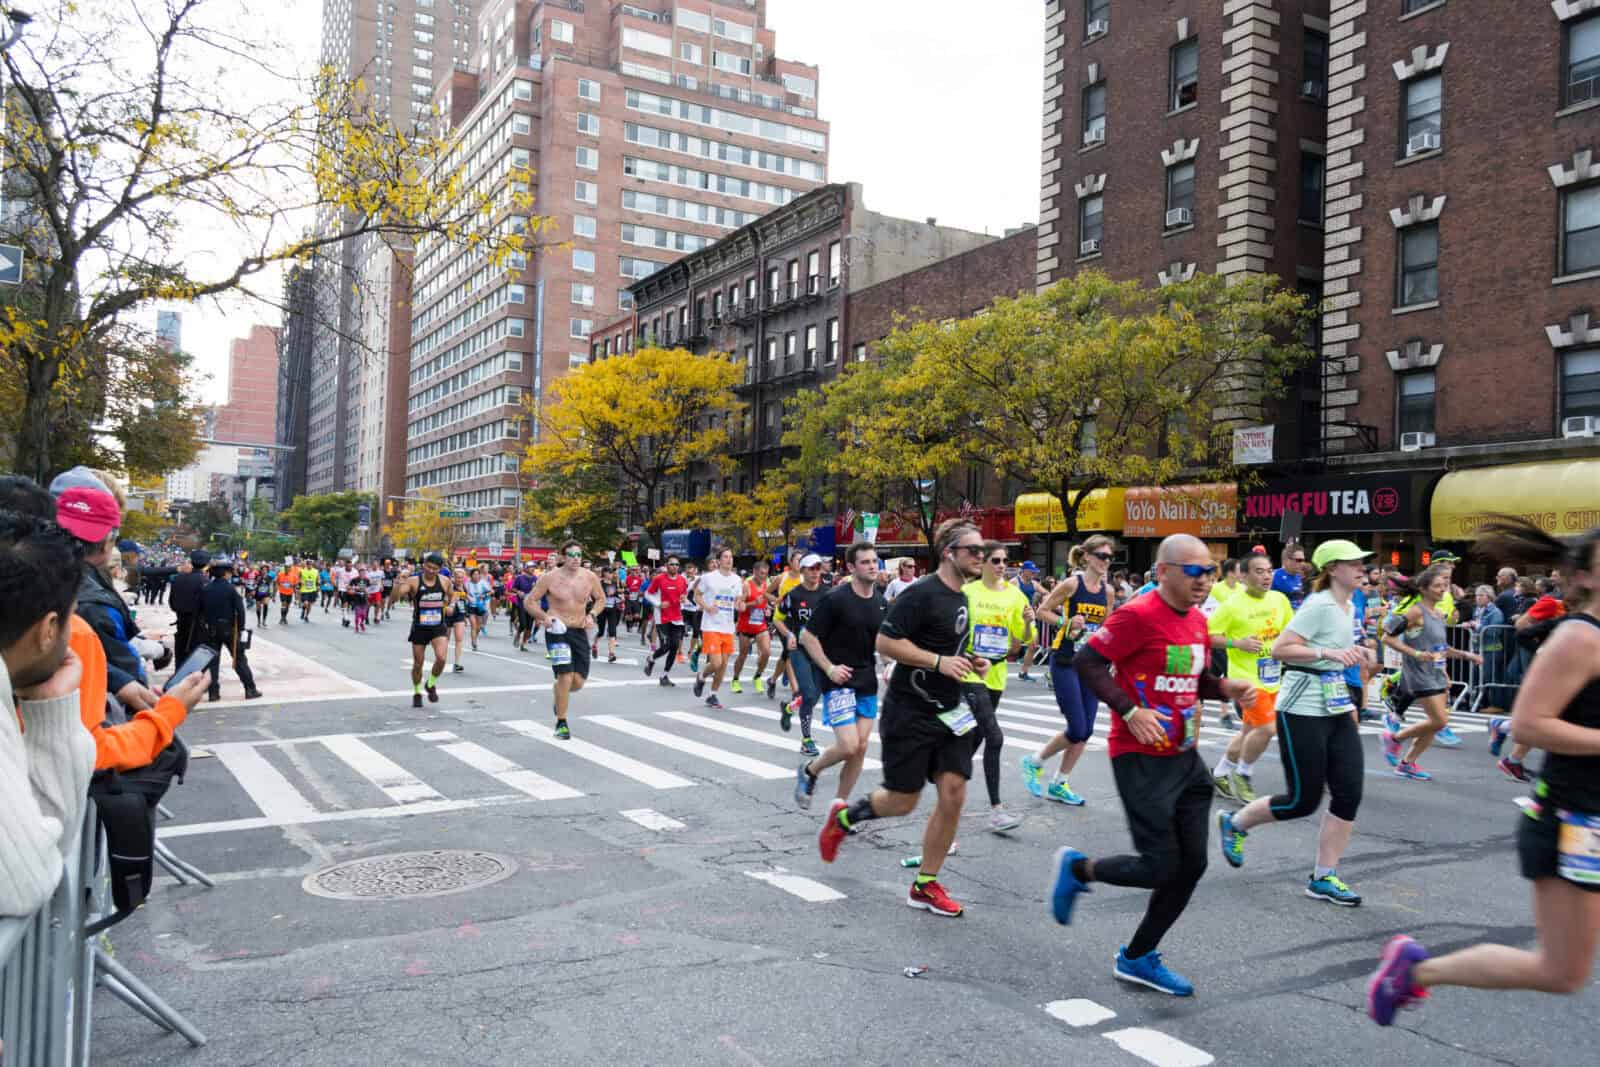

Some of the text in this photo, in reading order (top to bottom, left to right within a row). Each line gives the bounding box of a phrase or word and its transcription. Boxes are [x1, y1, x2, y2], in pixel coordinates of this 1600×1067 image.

[1126, 500, 1155, 521] YoYo
[1160, 500, 1187, 520] Nail
[1200, 499, 1228, 524] Spa
[1246, 492, 1299, 517] KUNG
[1302, 490, 1328, 515] FU
[1329, 489, 1370, 515] TEA
